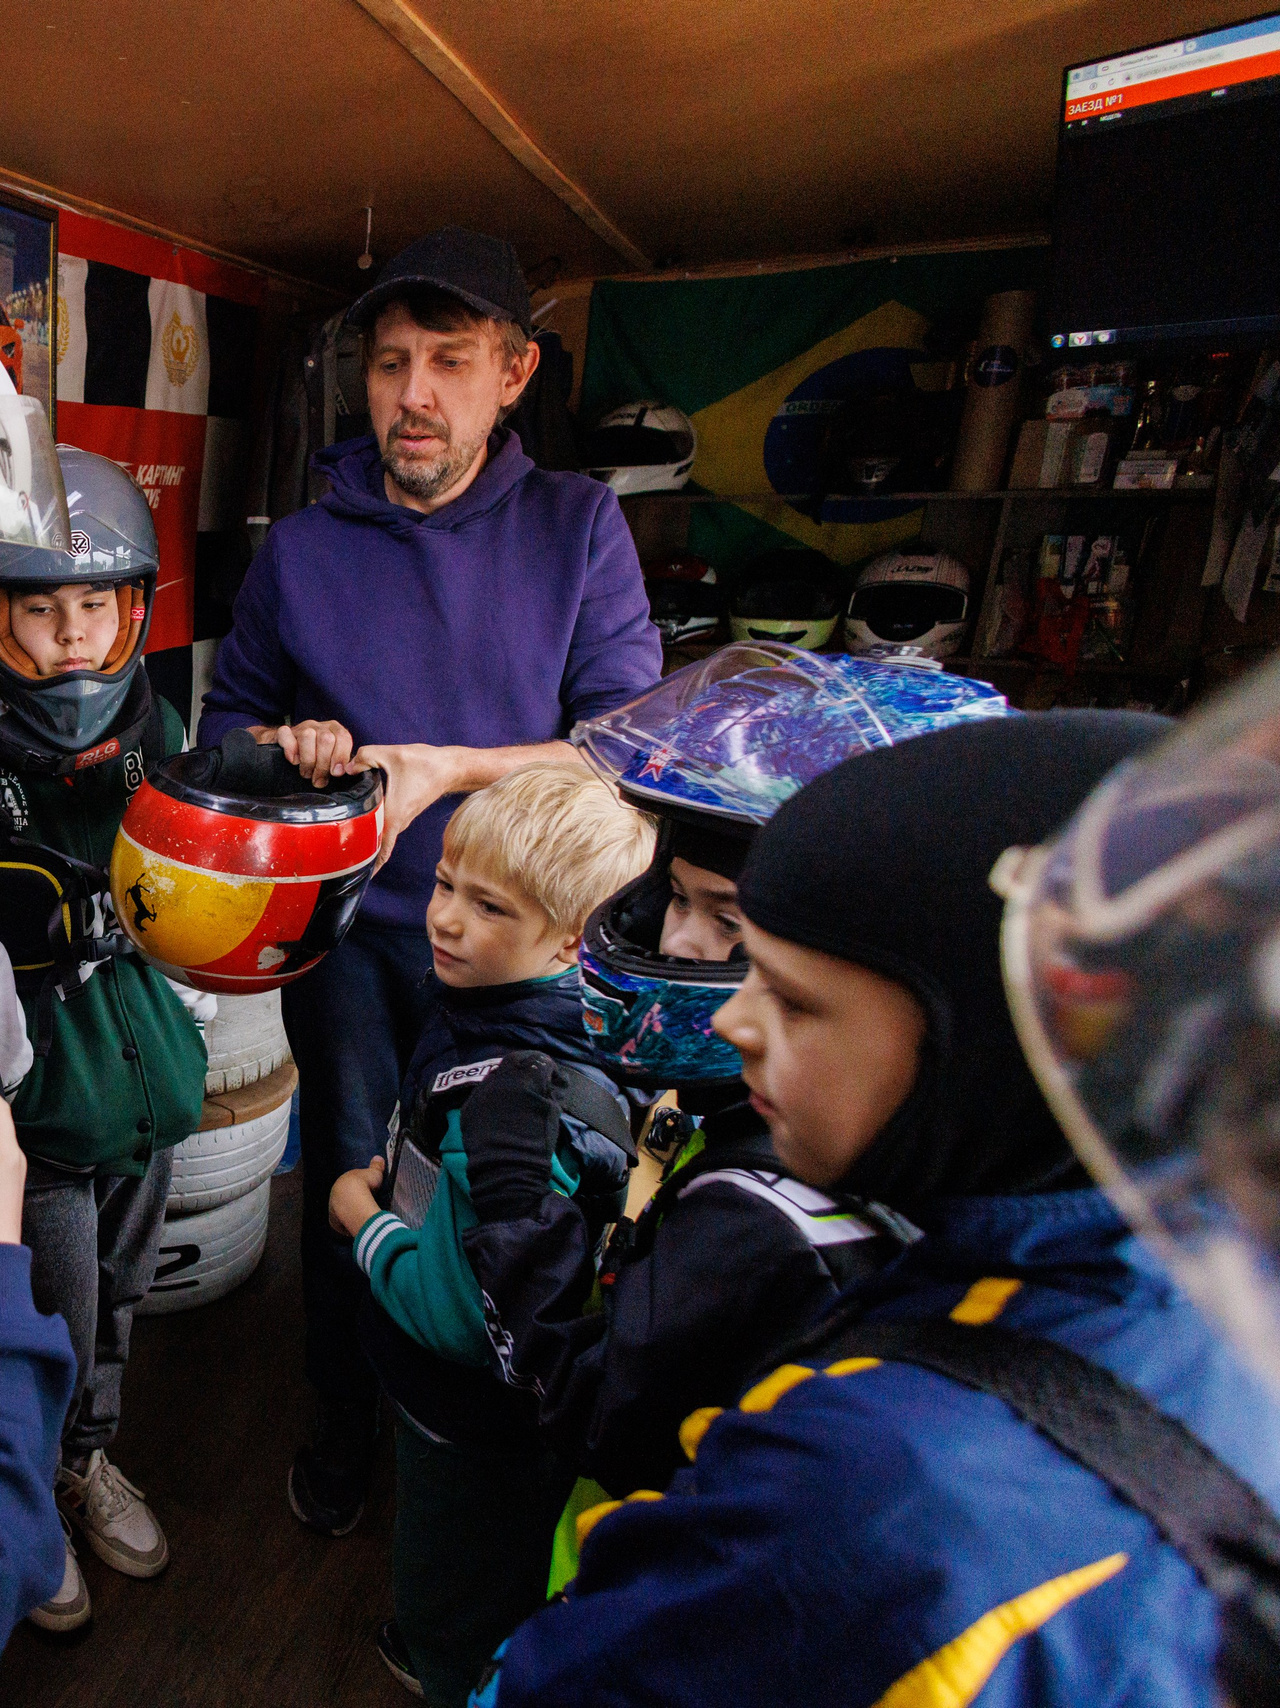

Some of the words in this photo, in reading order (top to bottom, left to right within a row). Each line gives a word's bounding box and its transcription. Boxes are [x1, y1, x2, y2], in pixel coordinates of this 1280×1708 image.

[1067, 98, 1104, 116] ЗАЕЗД
[1105, 93, 1124, 107] №1
[135, 464, 186, 486] КАРТИНГ
[80, 744, 117, 763] RLG
[147, 1243, 202, 1293] 2
